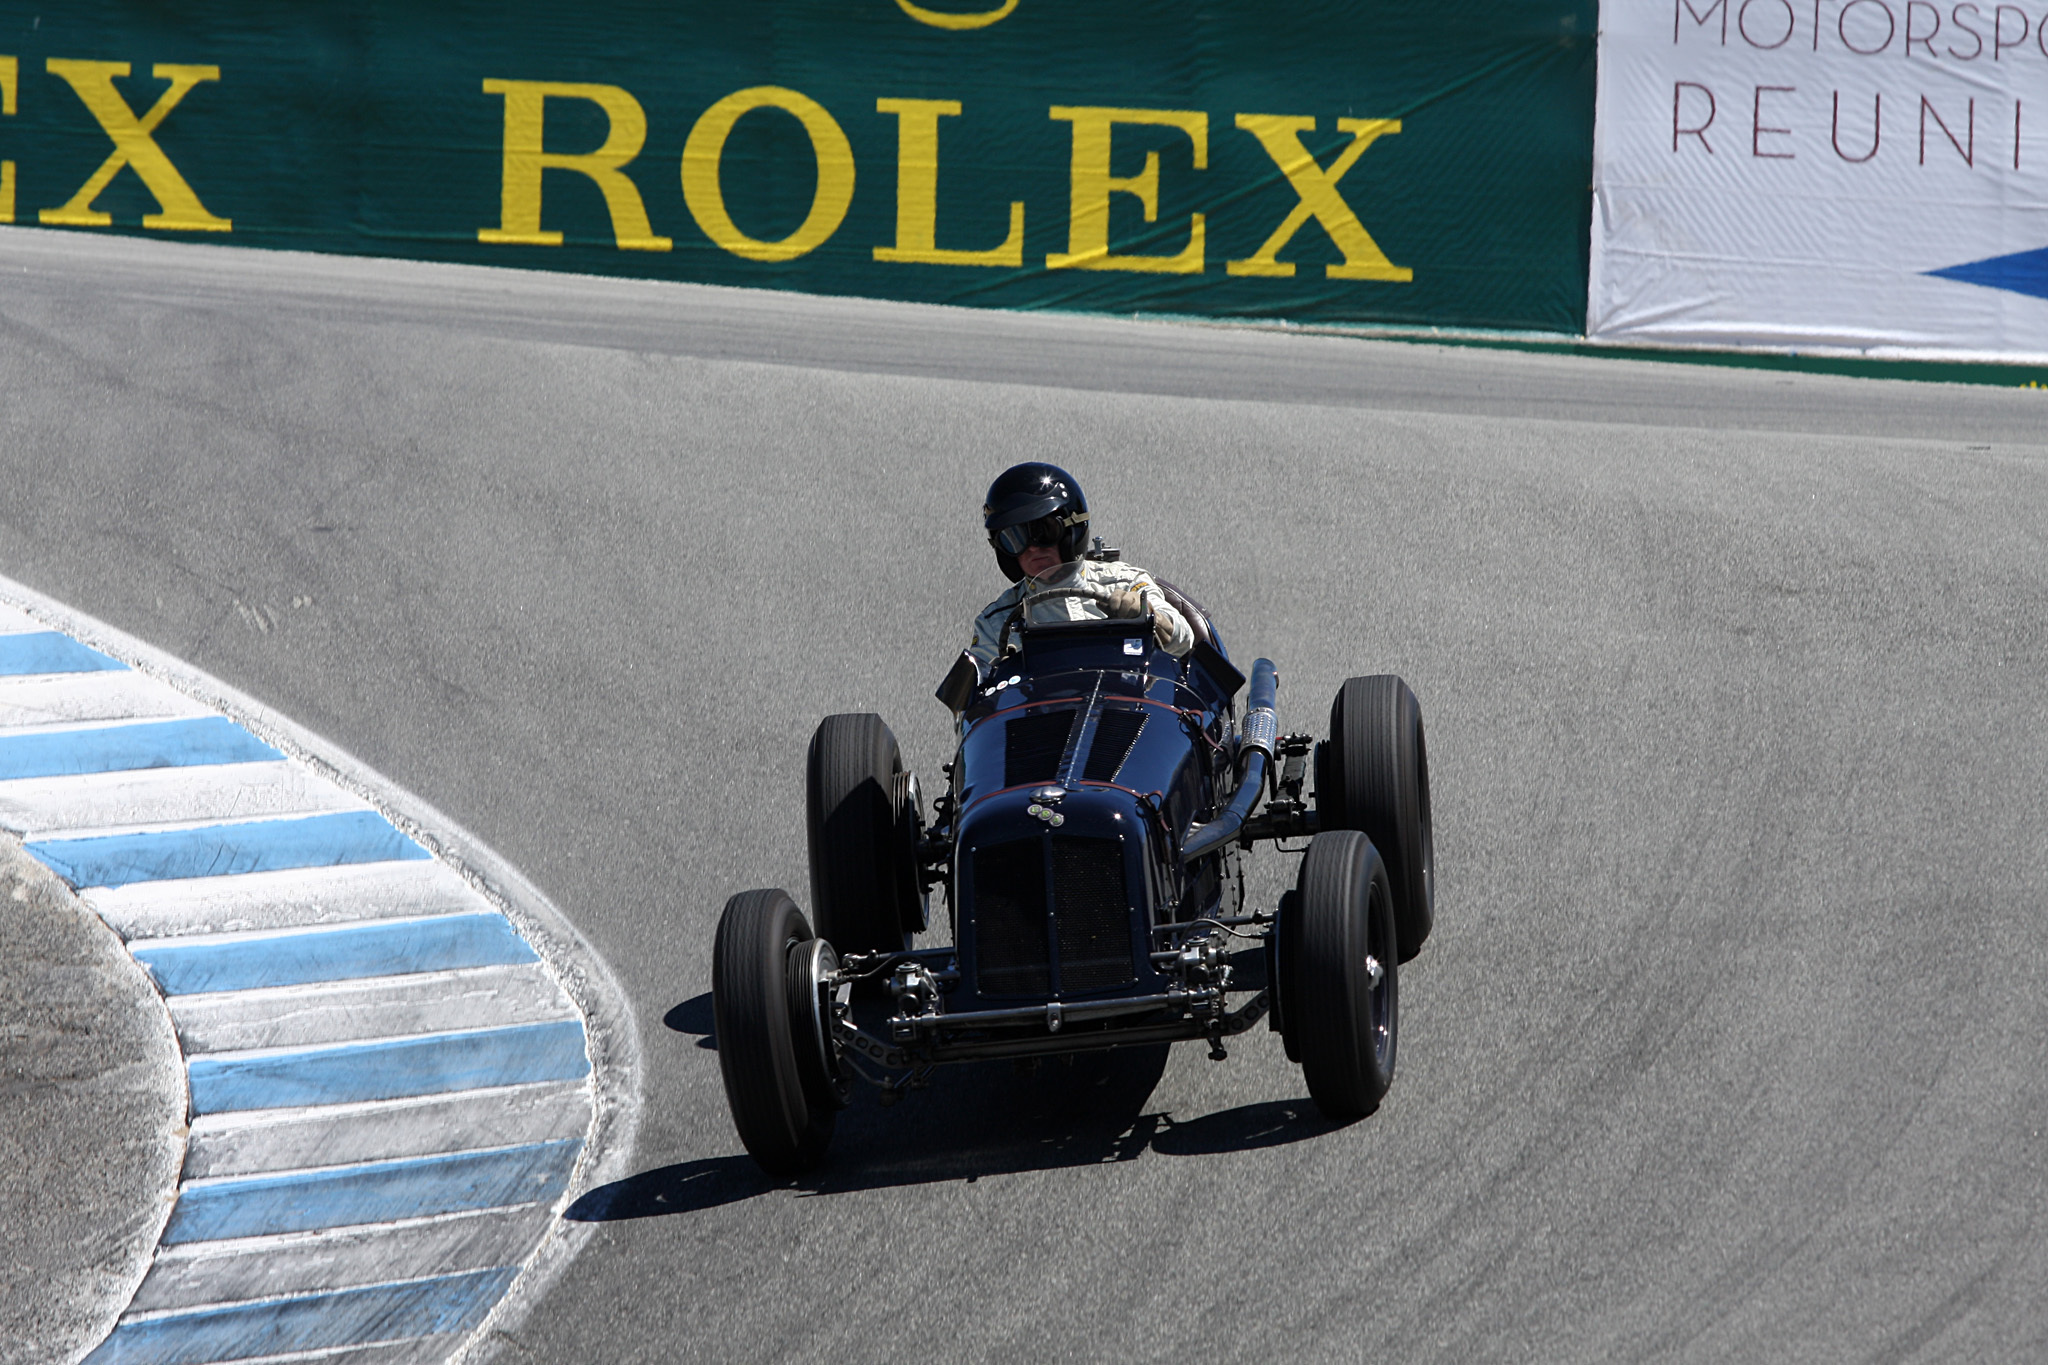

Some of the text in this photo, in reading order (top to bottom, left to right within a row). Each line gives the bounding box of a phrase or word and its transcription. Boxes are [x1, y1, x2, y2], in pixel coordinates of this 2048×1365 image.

[1673, 0, 2048, 62] MOTORSP
[0, 57, 1413, 282] X ROLEX
[1672, 81, 2022, 170] REUNI
